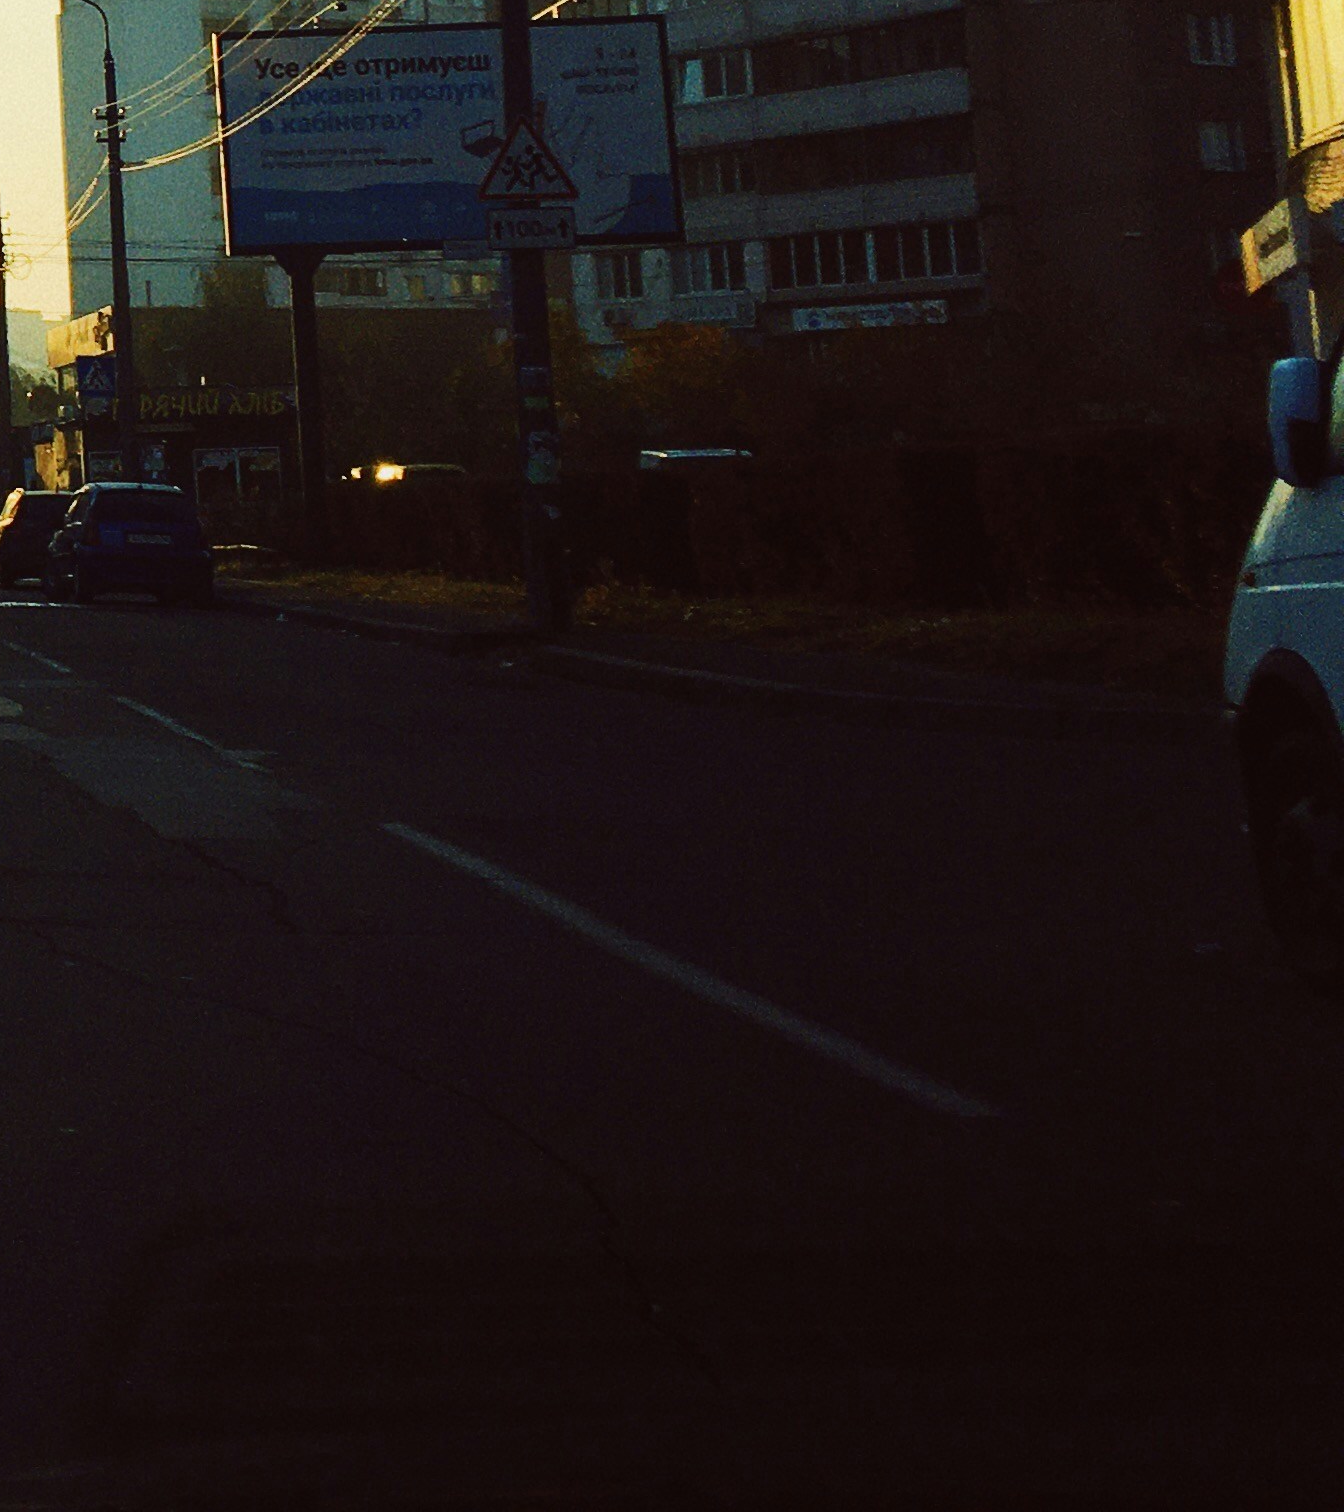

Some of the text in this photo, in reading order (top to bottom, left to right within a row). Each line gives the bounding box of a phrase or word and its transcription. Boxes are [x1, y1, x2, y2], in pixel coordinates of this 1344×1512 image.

[254, 57, 299, 80] Усе
[355, 54, 491, 80] отримуєш
[259, 80, 496, 110] ржавні послуги
[112, 388, 220, 422] ГРЯЧИЙ
